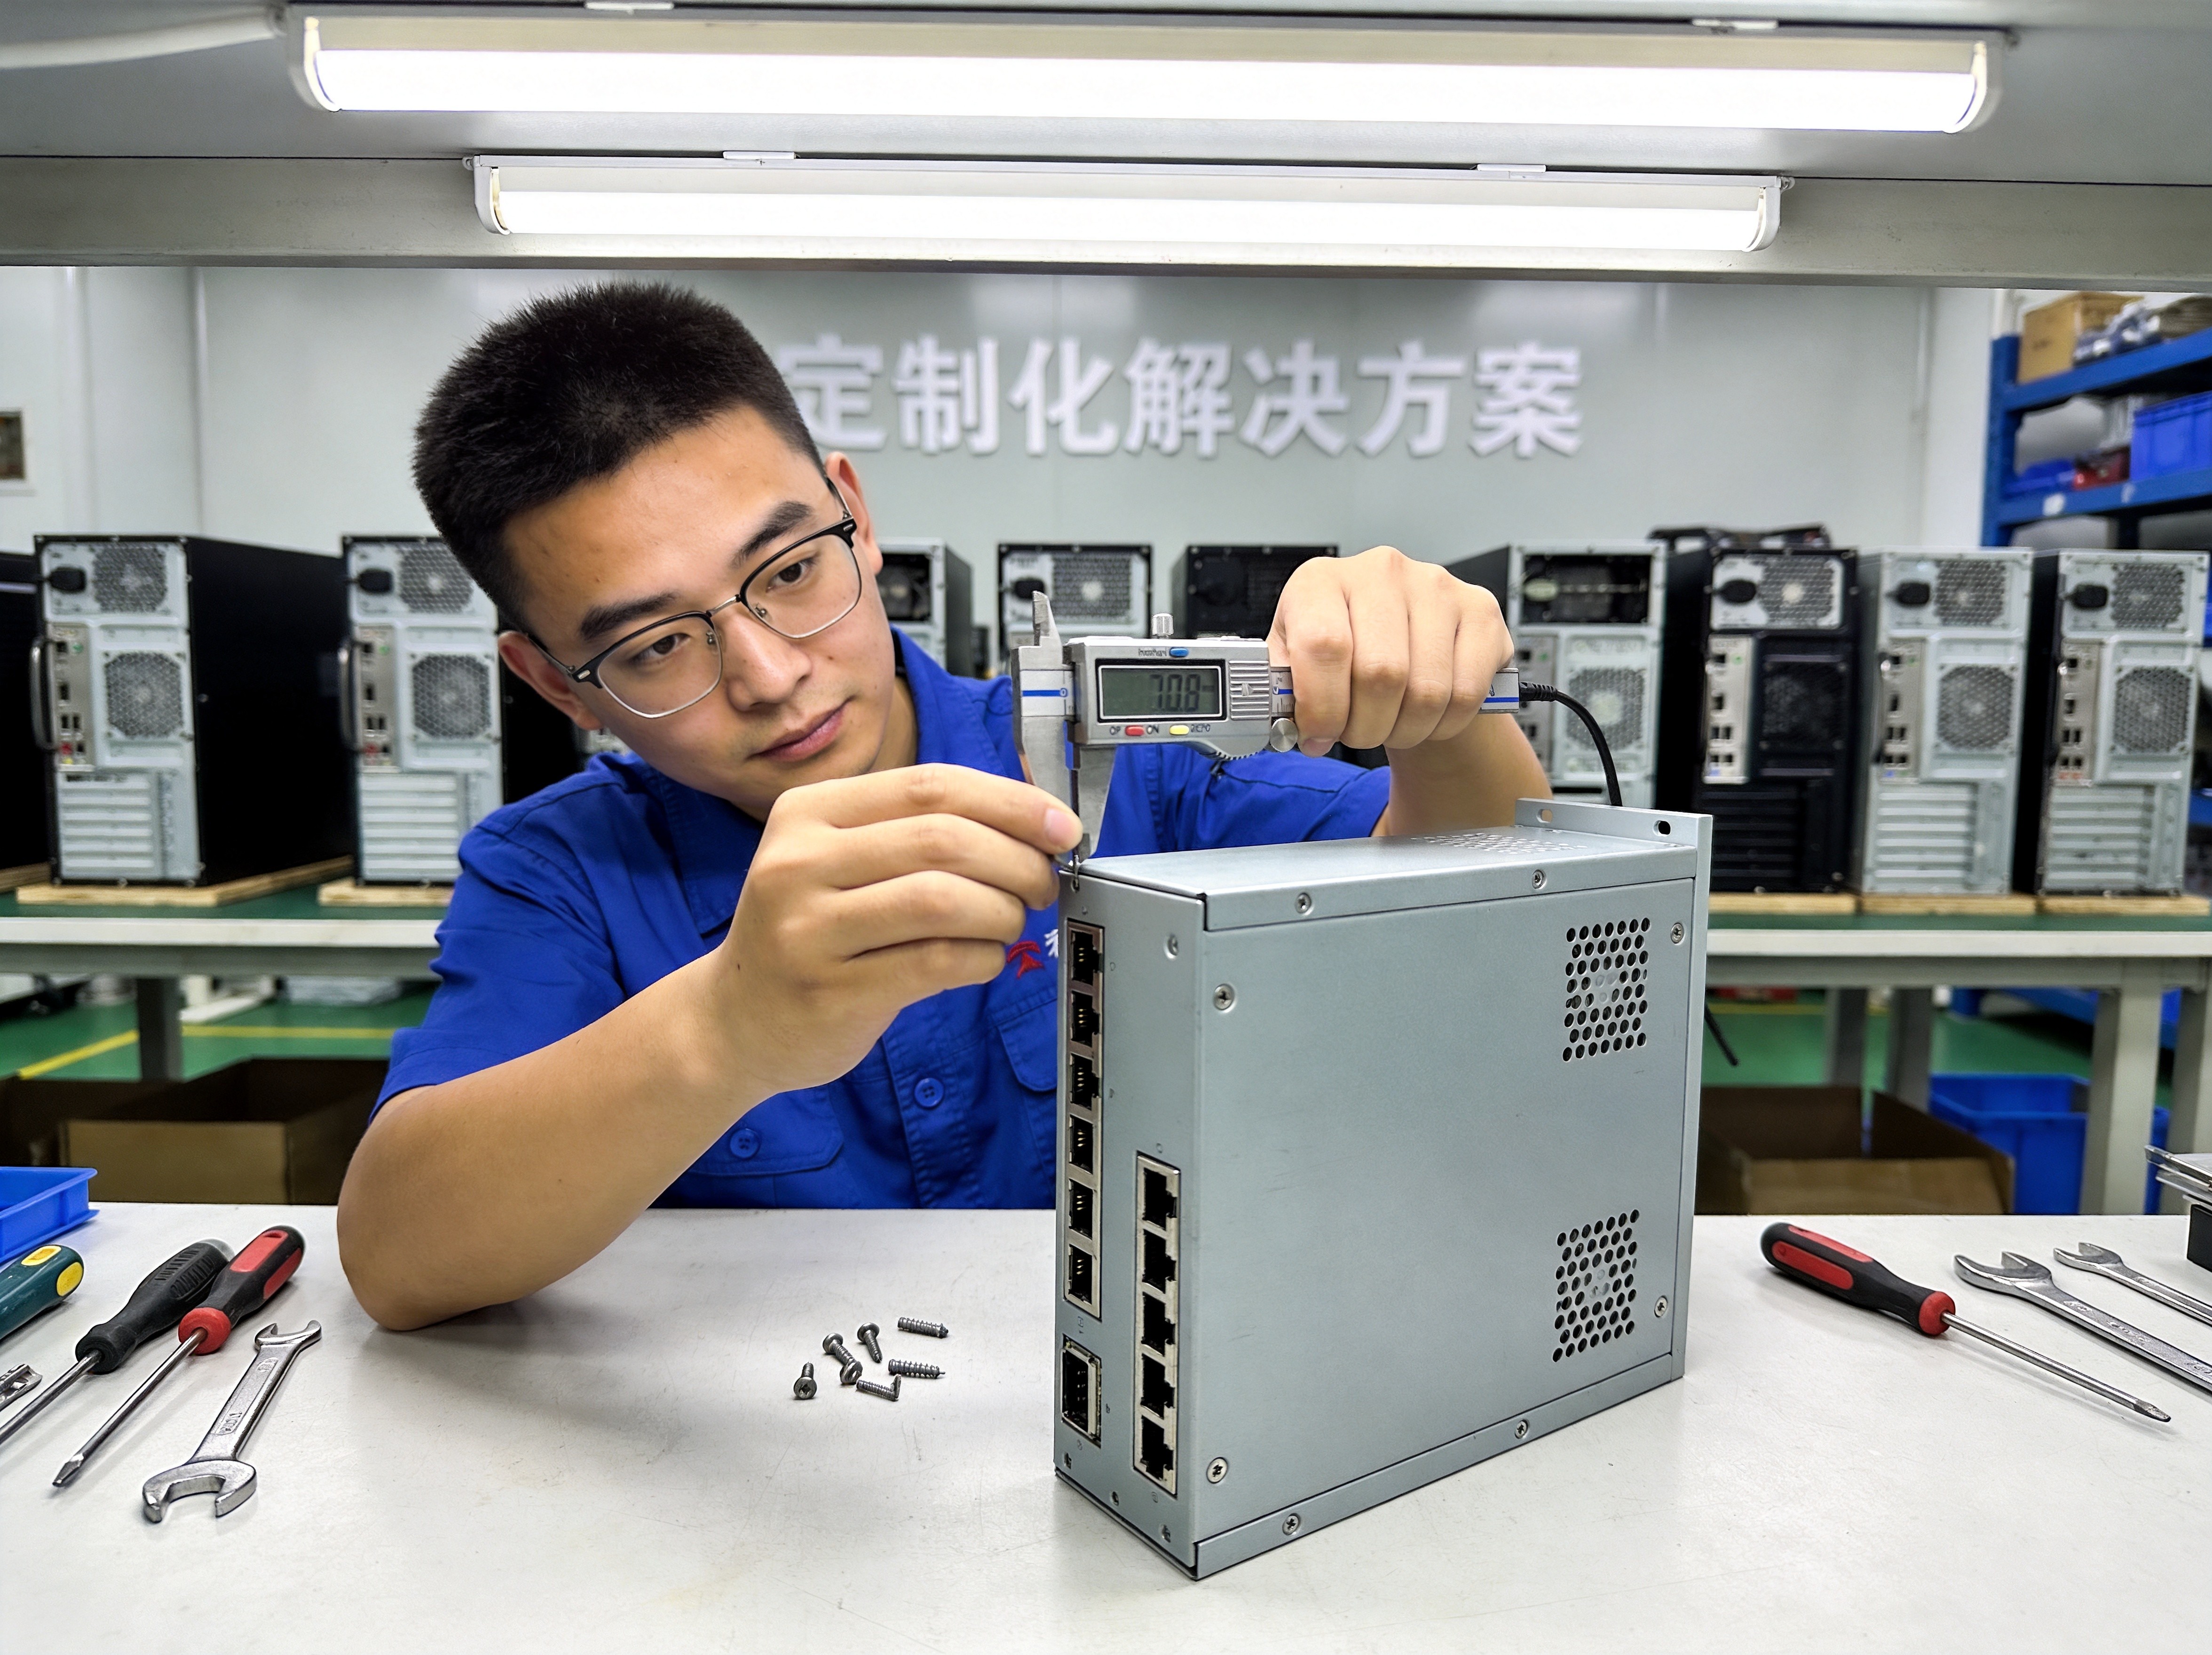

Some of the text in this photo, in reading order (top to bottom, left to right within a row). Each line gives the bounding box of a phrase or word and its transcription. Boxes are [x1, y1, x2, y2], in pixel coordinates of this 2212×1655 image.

[778, 332, 1583, 458] 定制化解决方案
